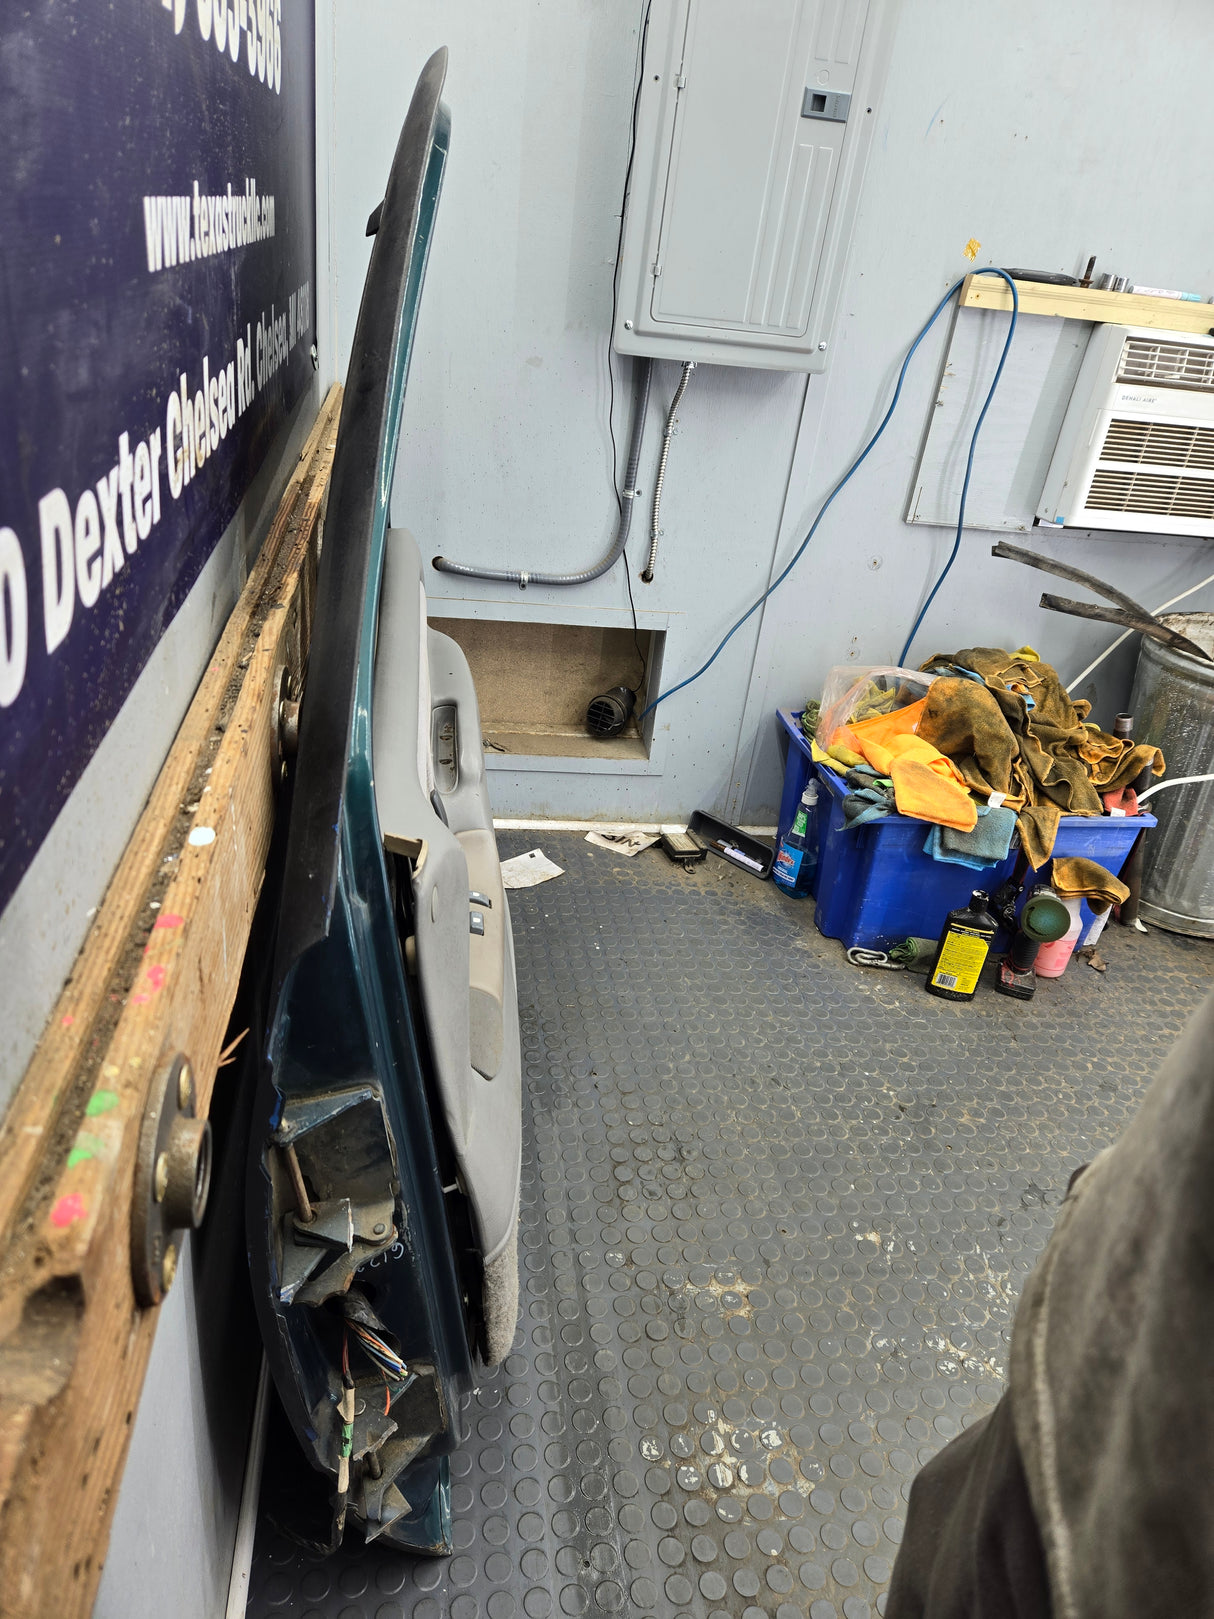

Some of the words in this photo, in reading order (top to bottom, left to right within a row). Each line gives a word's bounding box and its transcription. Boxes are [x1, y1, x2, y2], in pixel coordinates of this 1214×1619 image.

[38, 426, 161, 654] Dexter
[166, 356, 236, 499] Chelsea
[237, 322, 255, 417] Rd.
[256, 304, 288, 392] Chelsea,
